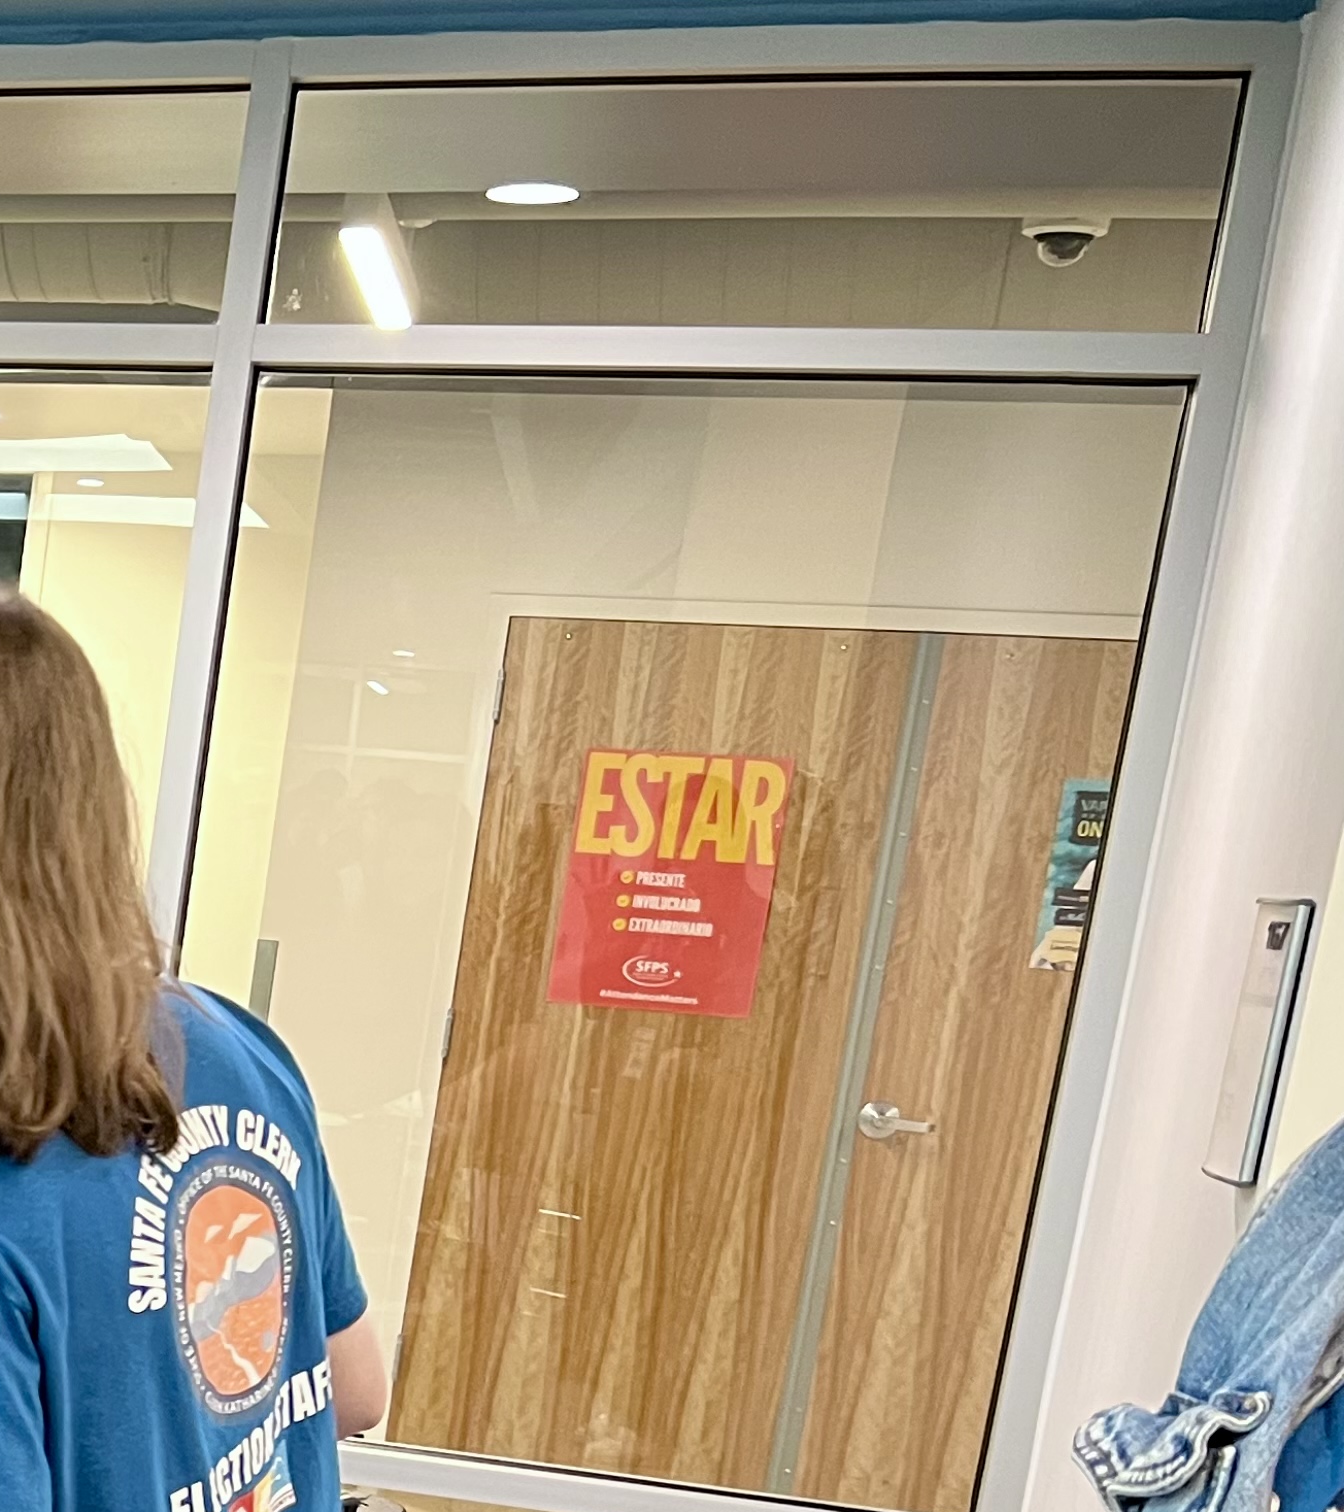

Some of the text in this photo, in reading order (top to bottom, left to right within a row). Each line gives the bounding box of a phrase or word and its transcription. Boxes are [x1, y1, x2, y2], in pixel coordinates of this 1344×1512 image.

[574, 751, 787, 866] ESTAR
[632, 894, 701, 913] INVOLUCRADO
[635, 870, 687, 888] PRESENTE
[628, 917, 713, 937] EXTRAORDINARIO
[635, 960, 669, 974] SFPS
[138, 1154, 174, 1205] FE
[236, 1108, 301, 1191] CLERK
[228, 1165, 261, 1189] SANTA
[271, 1195, 292, 1245] COUNTY
[127, 1196, 168, 1315] SANTA
[273, 1354, 333, 1440] STAF
